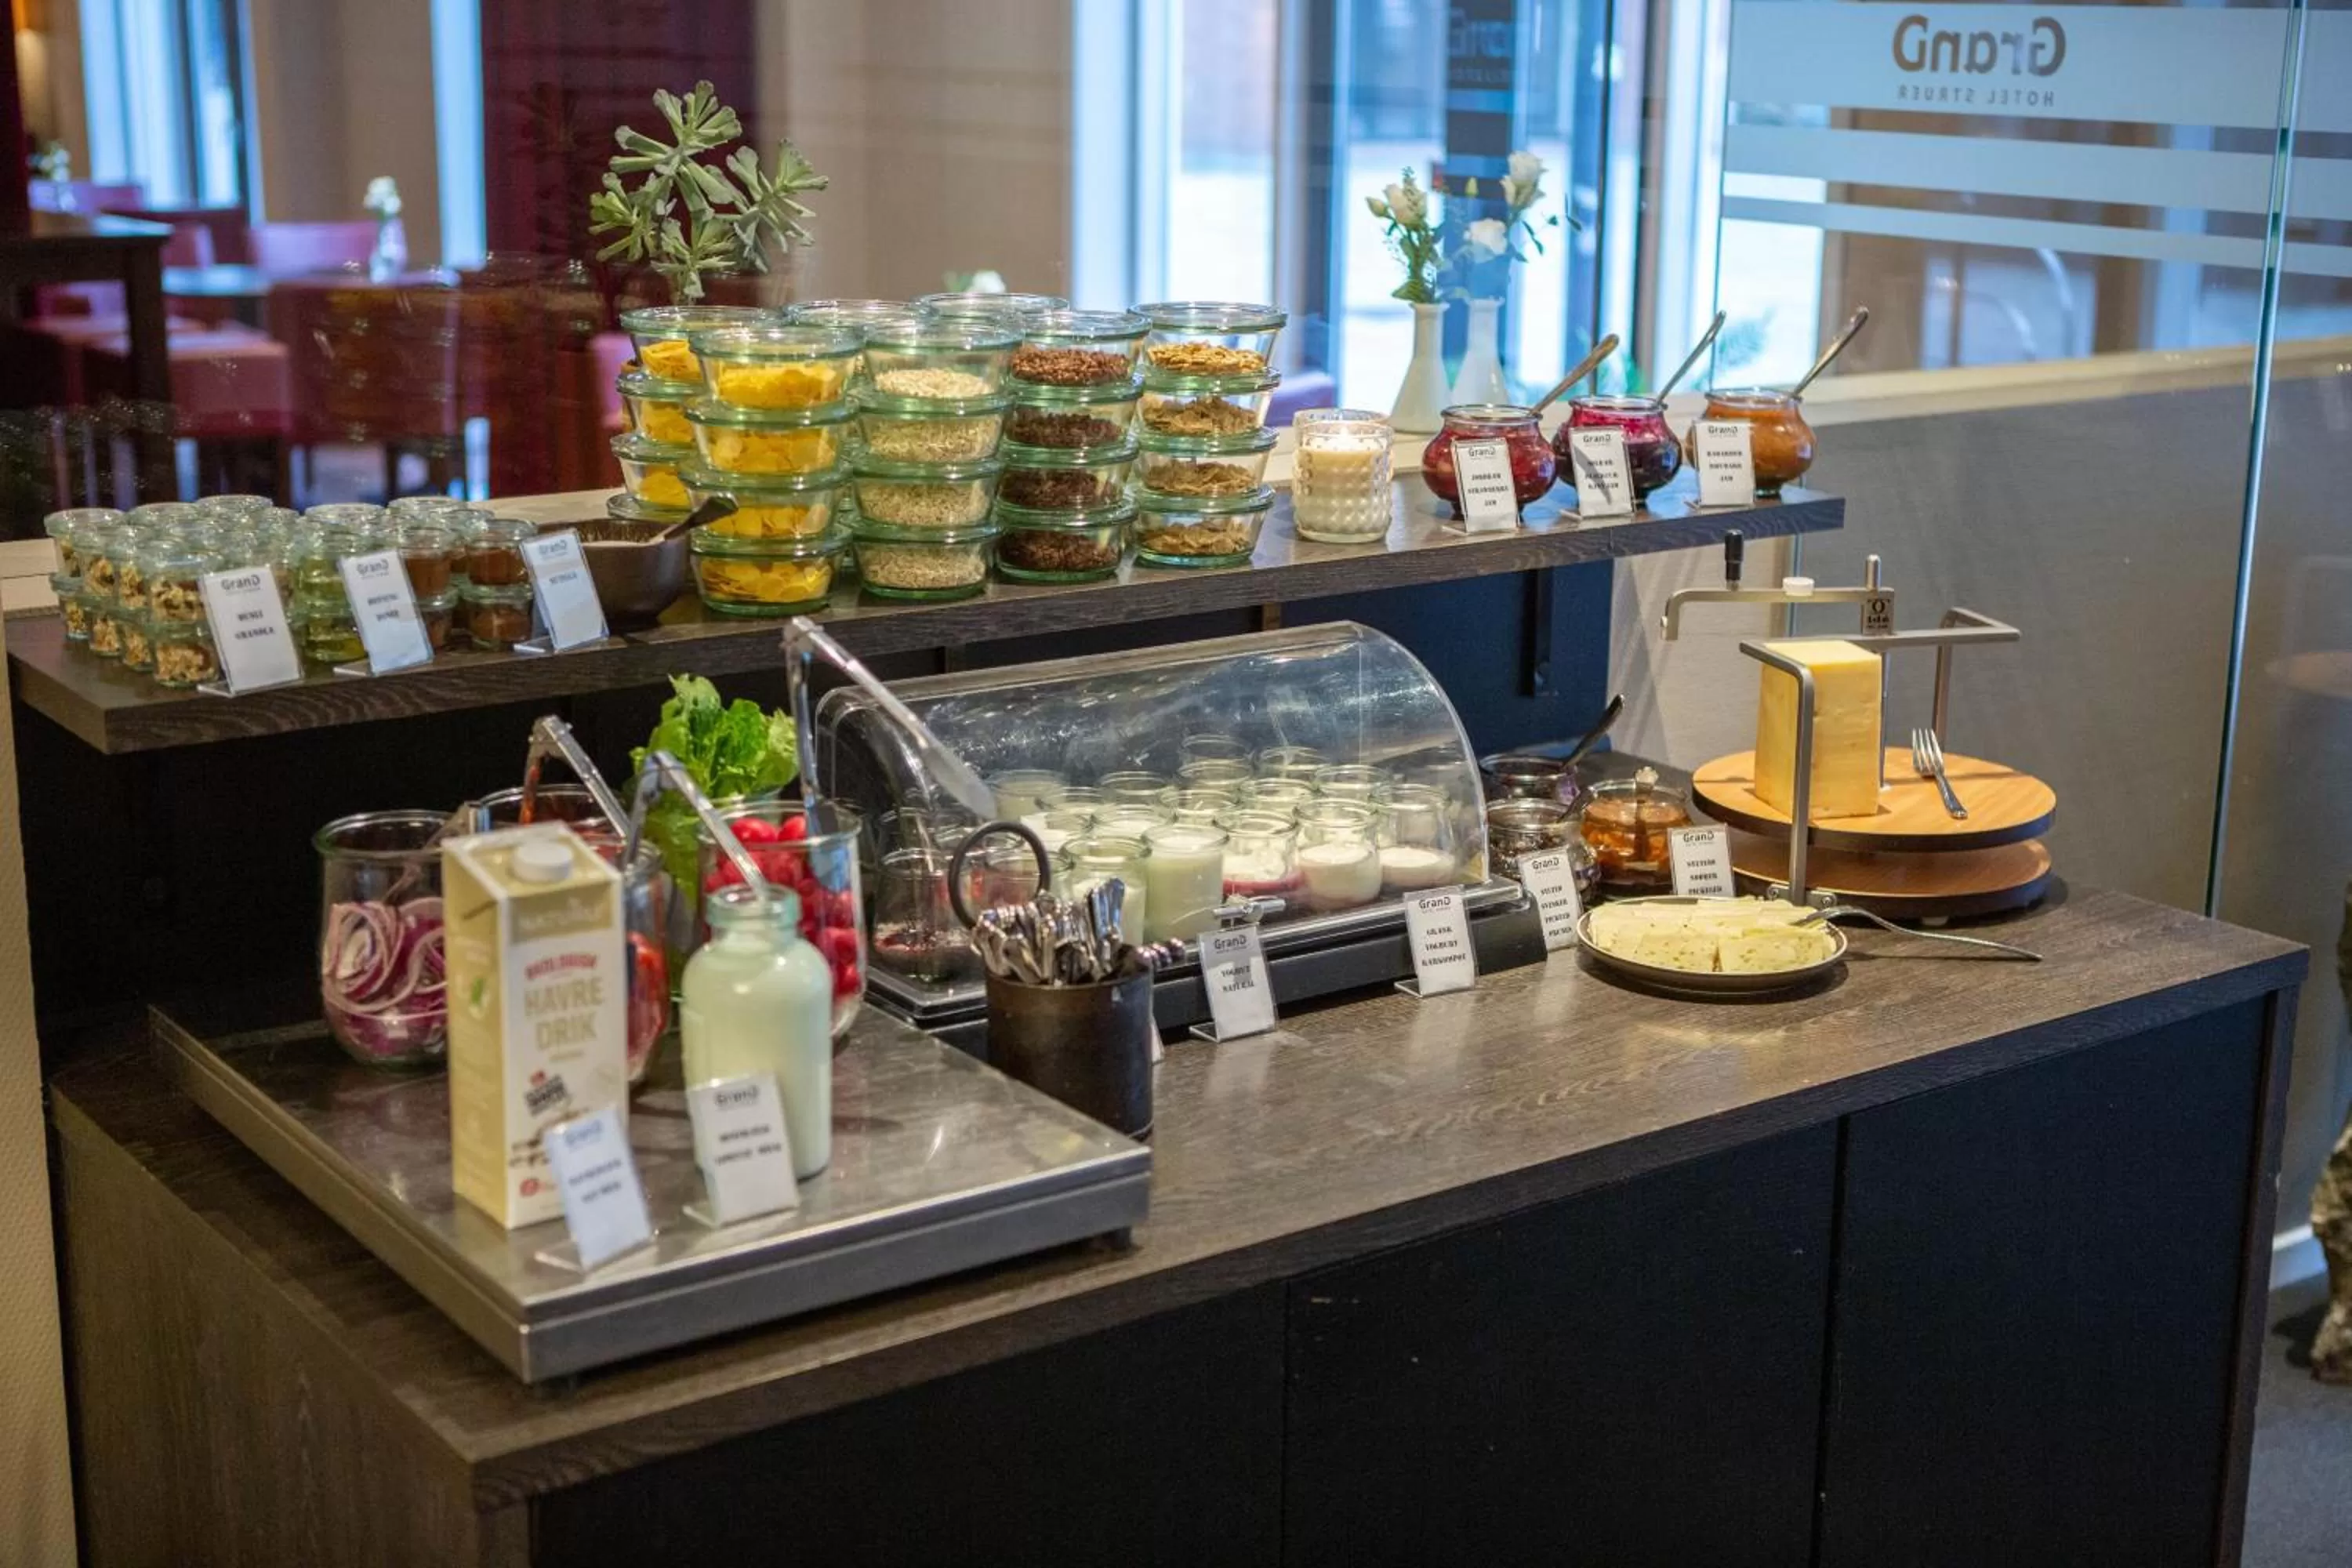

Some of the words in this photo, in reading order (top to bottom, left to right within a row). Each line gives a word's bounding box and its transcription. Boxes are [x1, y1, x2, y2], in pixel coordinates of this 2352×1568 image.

[1708, 426, 1738, 434] GranD
[1583, 434, 1611, 443] GranD
[1469, 446, 1496, 457] GranD
[221, 574, 261, 590] GranD
[1683, 831, 1715, 843] GranD
[1532, 857, 1559, 869] GranD
[1418, 897, 1451, 909] GranD
[1214, 934, 1247, 949] GranD
[524, 975, 604, 1017] HAVRE
[536, 1013, 597, 1052] DRIK
